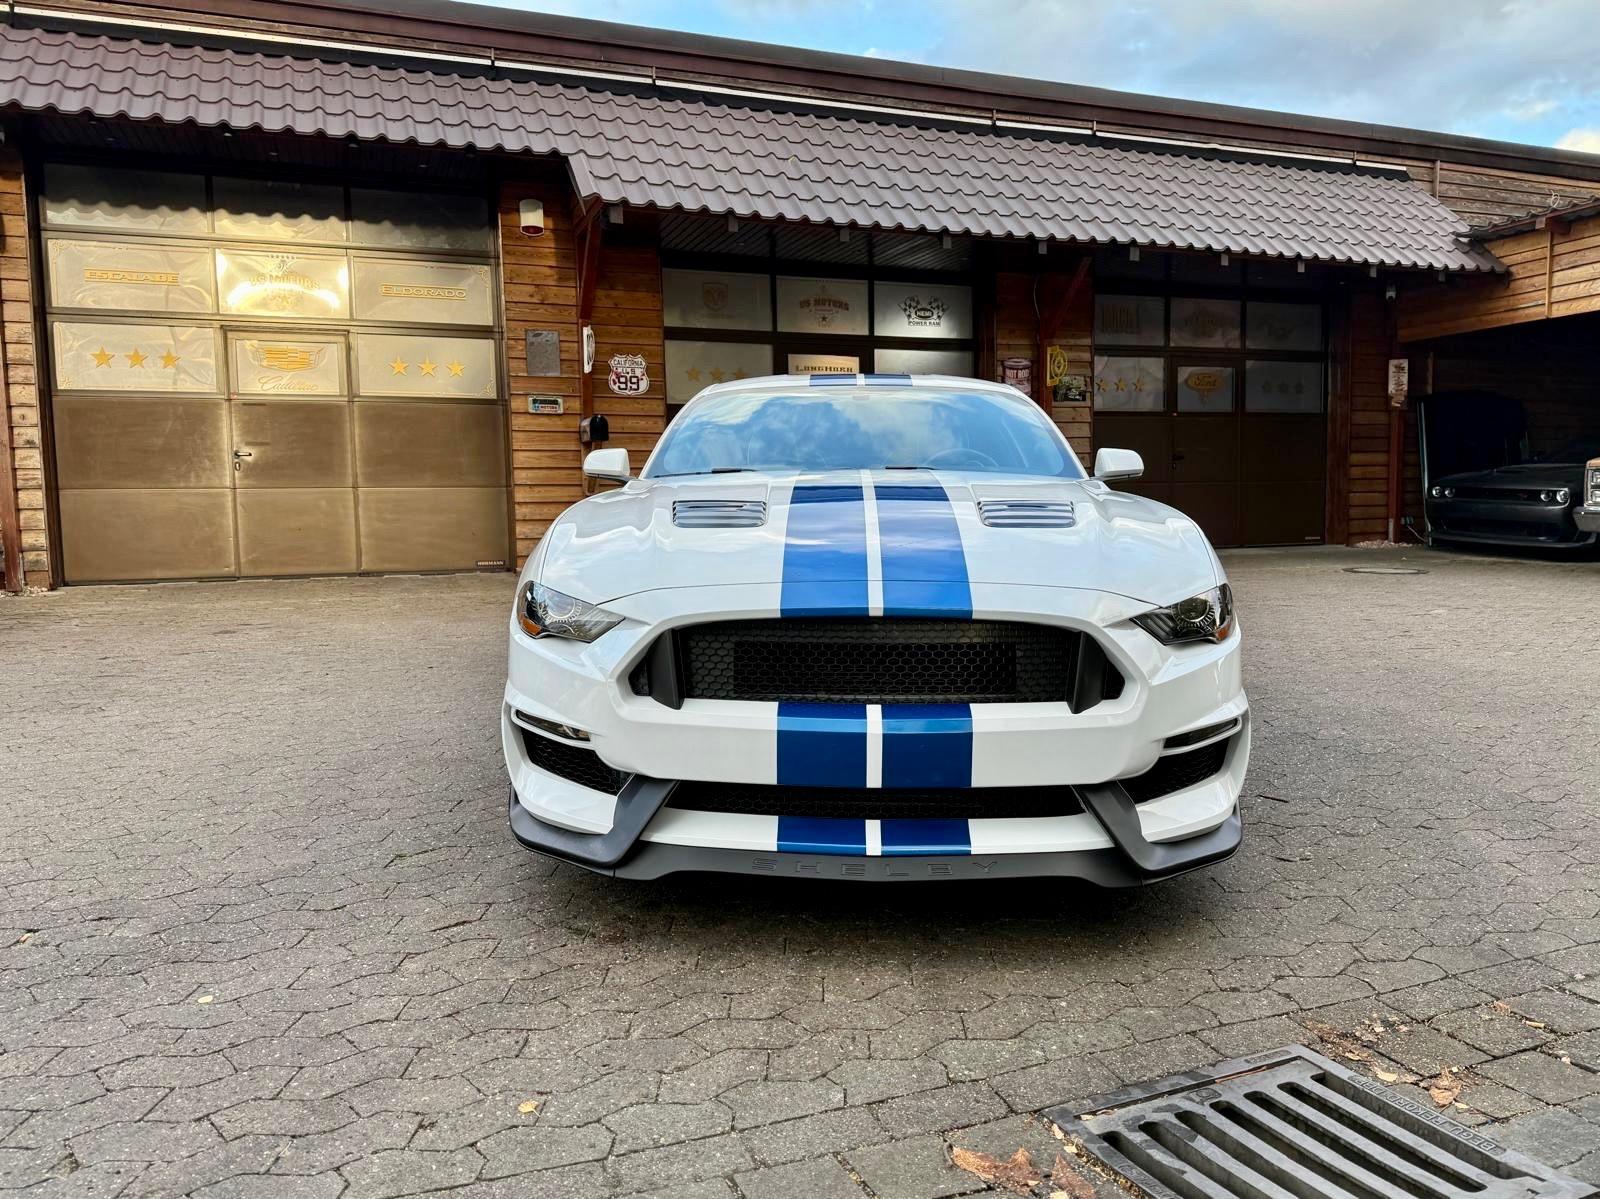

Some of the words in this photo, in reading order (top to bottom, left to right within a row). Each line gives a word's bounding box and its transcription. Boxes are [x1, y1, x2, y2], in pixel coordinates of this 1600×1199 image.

[382, 285, 466, 298] ELDORADO
[613, 358, 644, 367] CALIFORNIA
[617, 375, 640, 391] 99
[752, 857, 998, 877] SHELBY
[1386, 1093, 1448, 1126] REKORD
[1449, 1126, 1497, 1152] BEGU
